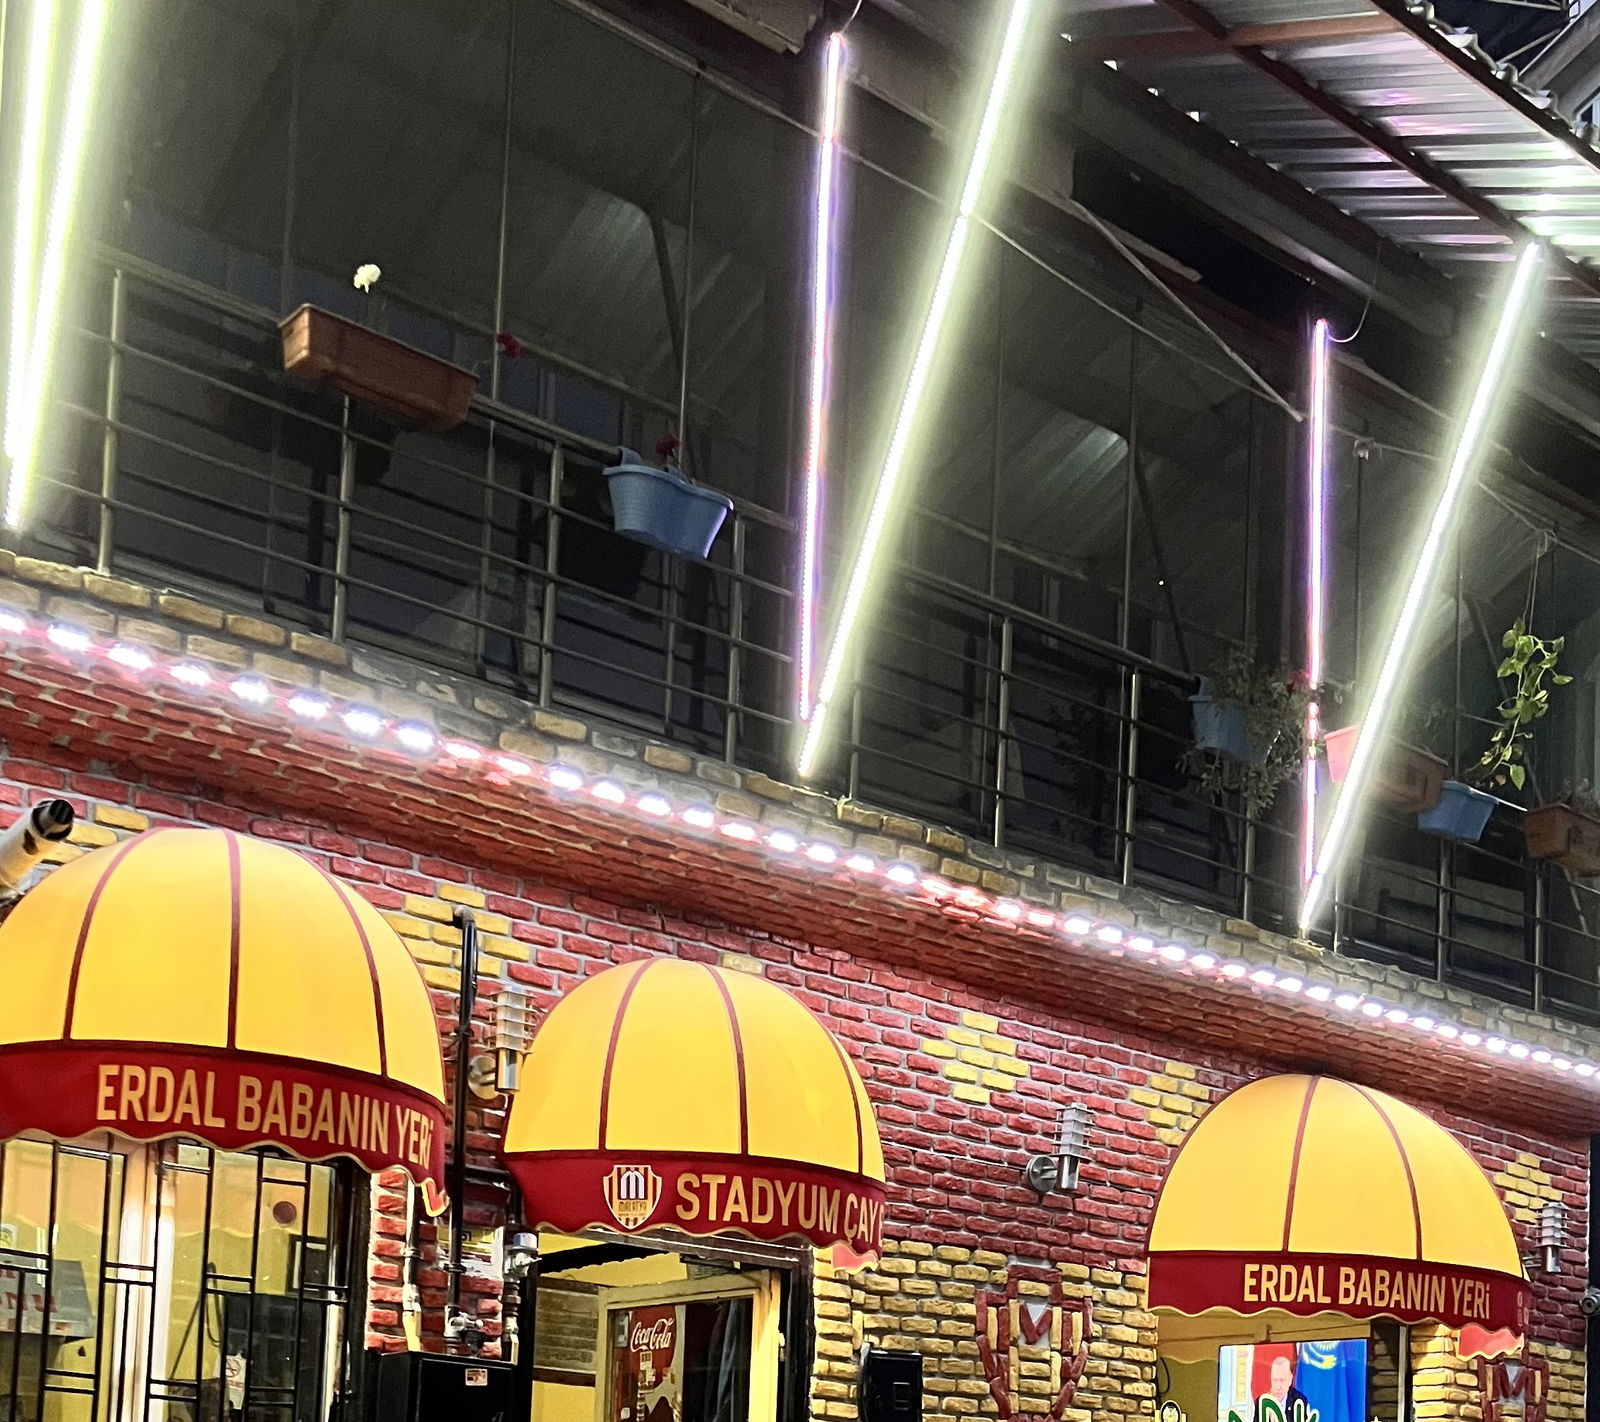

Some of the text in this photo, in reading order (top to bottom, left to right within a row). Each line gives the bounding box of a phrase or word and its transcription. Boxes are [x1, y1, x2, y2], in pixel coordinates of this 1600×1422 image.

[96, 1064, 226, 1128] ERDAL
[236, 1075, 390, 1156] BABANIN
[676, 1173, 841, 1234] STADYUM
[1243, 1263, 1332, 1305] ERDAL
[1338, 1266, 1446, 1312] BABANIN
